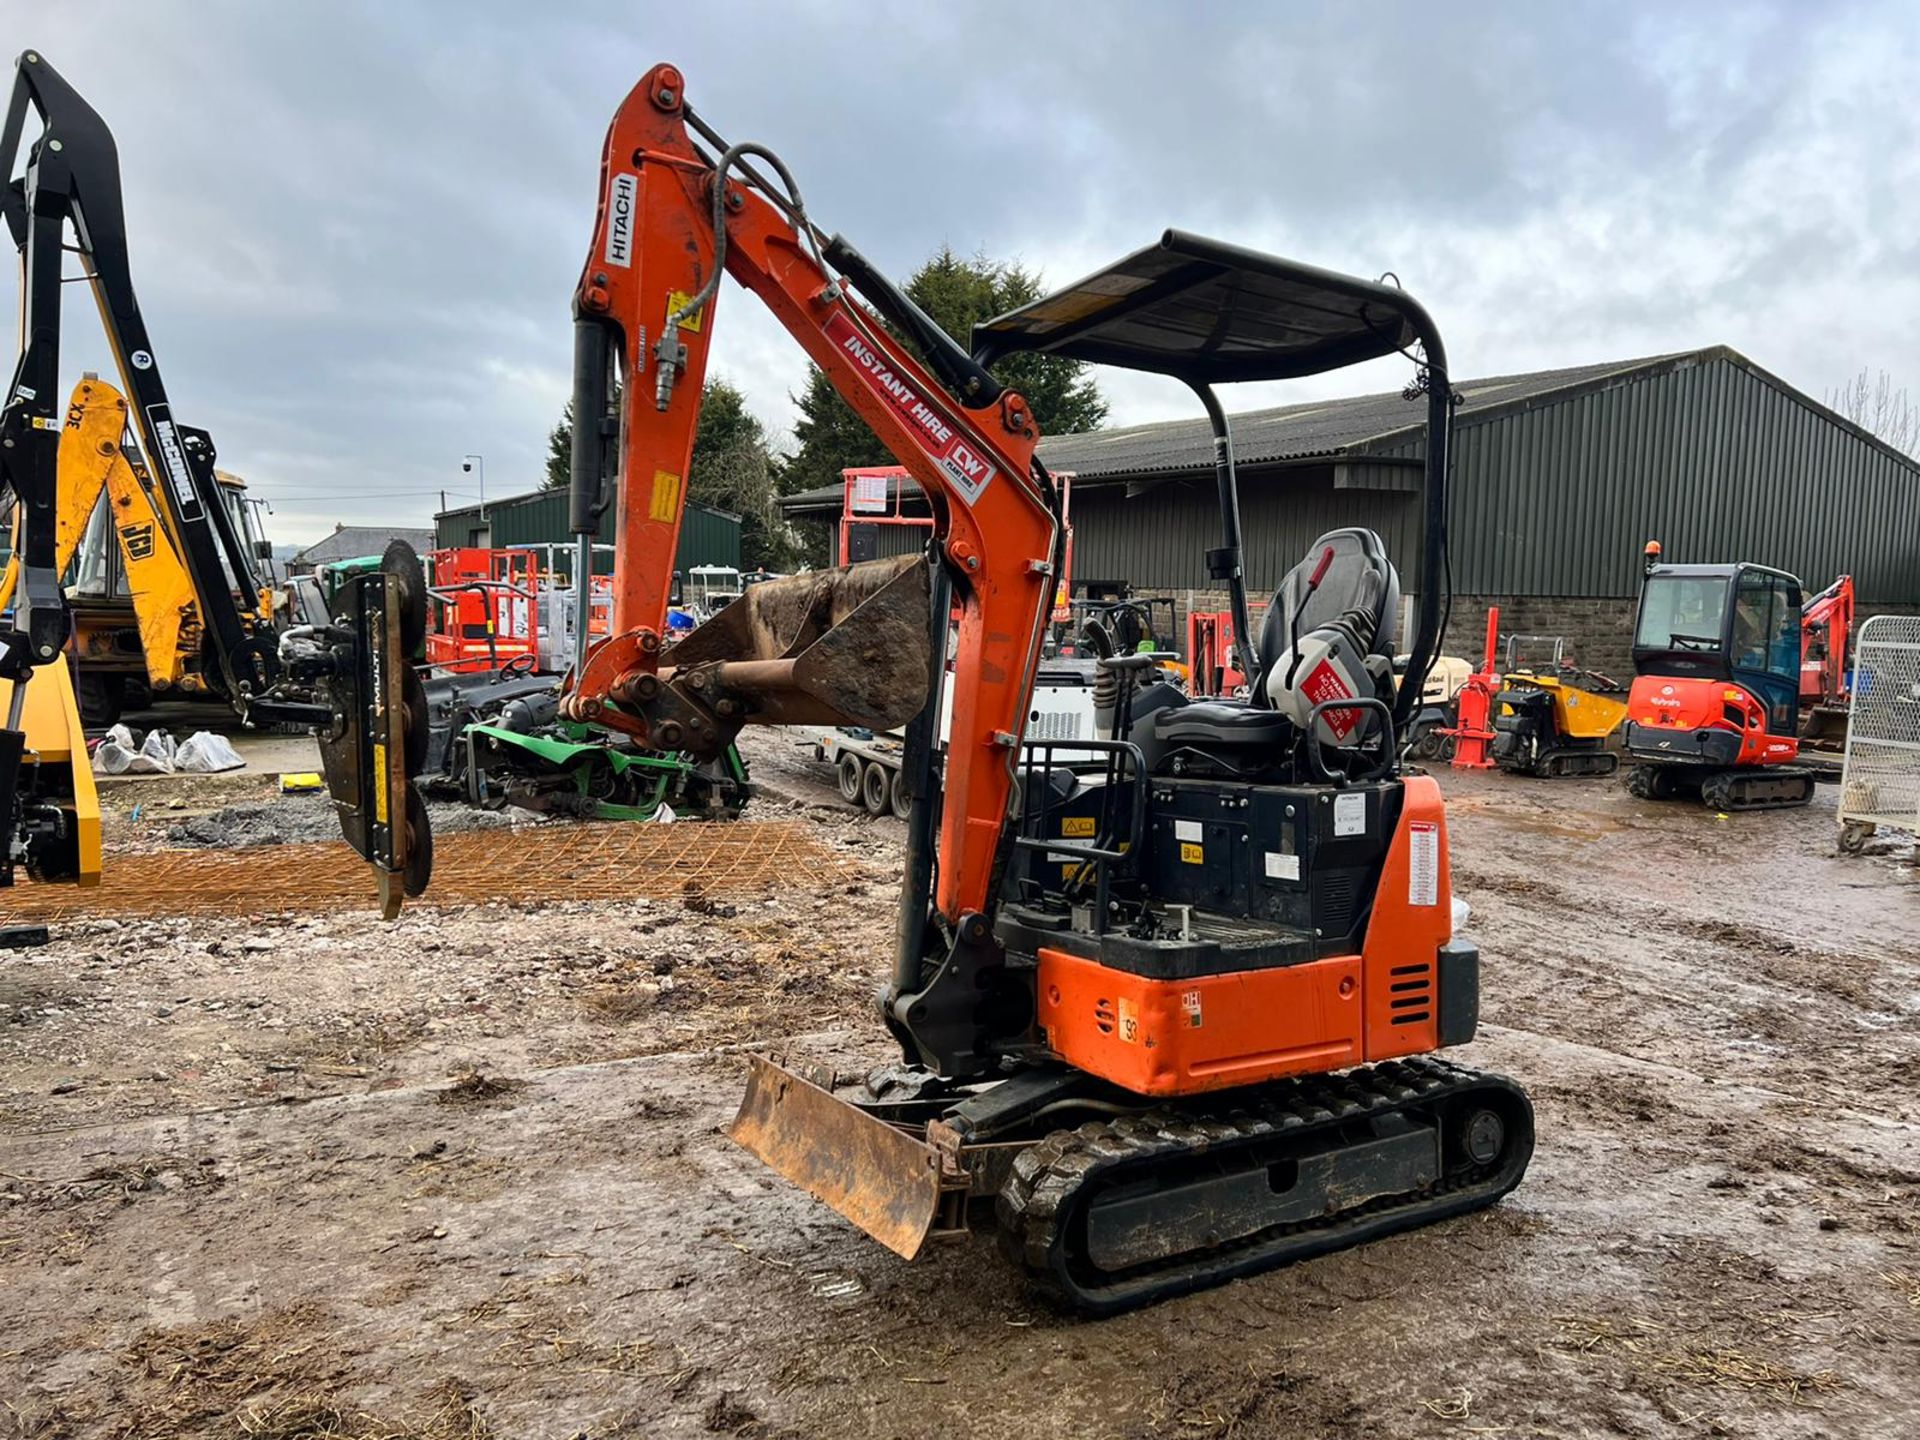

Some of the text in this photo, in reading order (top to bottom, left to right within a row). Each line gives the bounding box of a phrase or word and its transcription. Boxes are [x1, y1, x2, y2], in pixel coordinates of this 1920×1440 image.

[612, 178, 632, 261] HITACHI
[844, 336, 953, 443] INSTANT HIRE
[66, 403, 86, 429] 3CX
[946, 461, 973, 489] PLANT HIRE
[952, 444, 984, 476] CW
[121, 525, 152, 557] JCB
